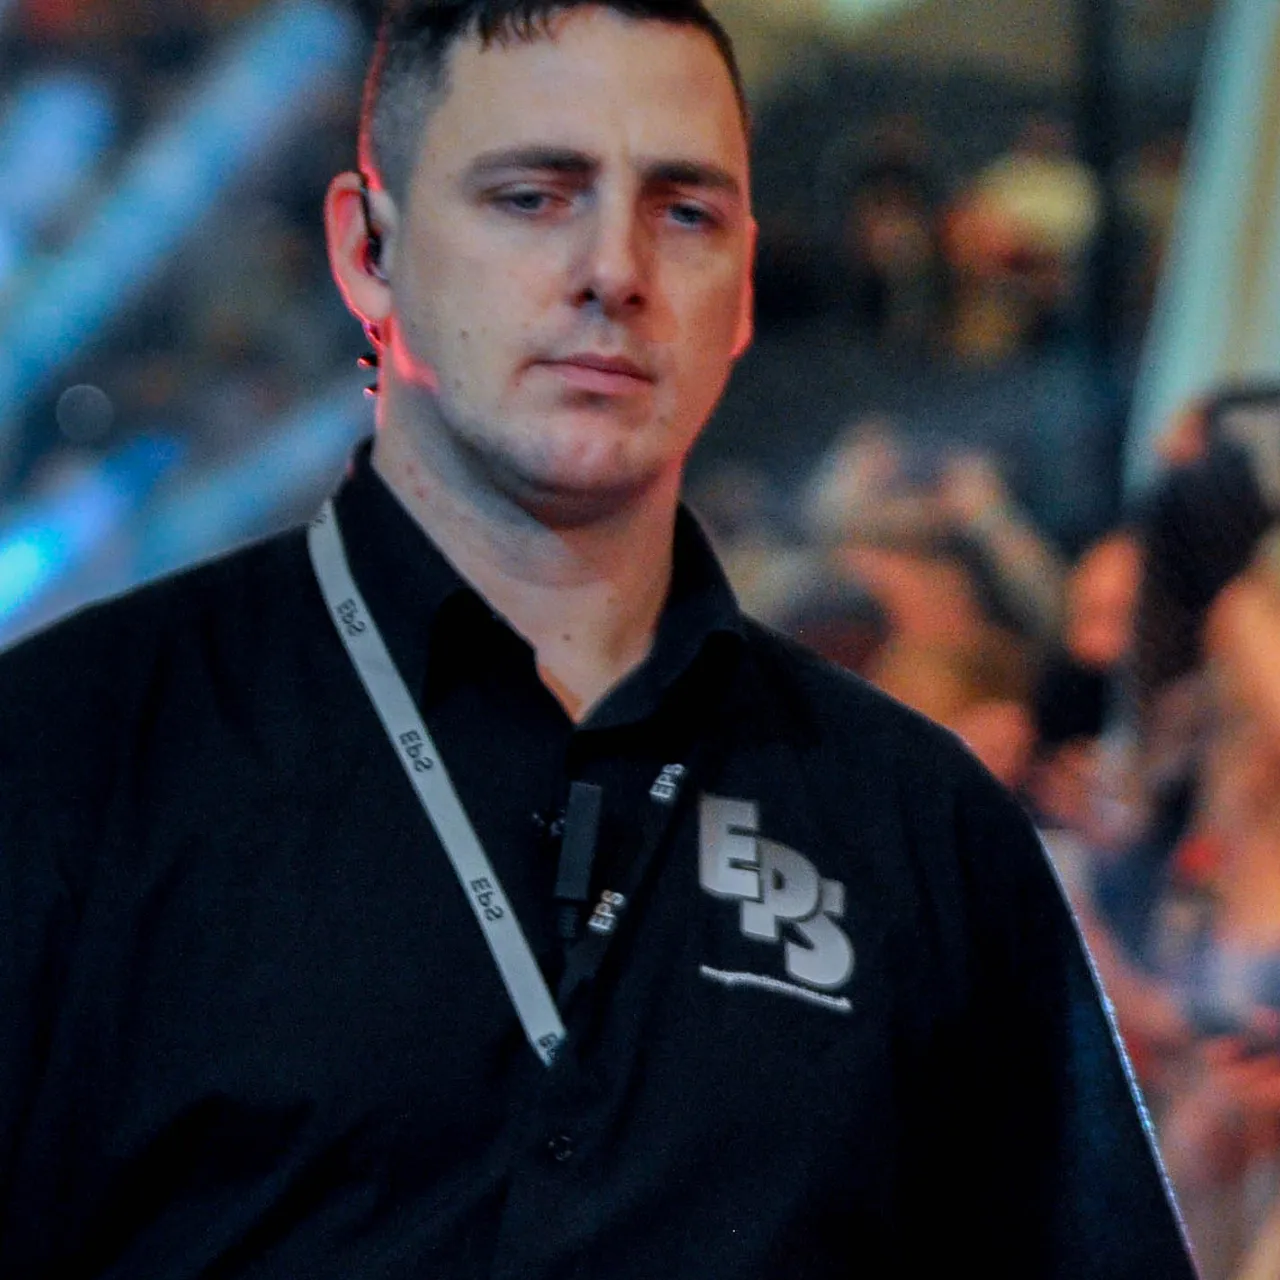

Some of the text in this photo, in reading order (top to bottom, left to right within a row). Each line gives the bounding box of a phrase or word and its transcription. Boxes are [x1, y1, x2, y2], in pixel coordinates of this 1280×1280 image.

[650, 763, 684, 799] EPS
[588, 889, 624, 932] EPS
[698, 796, 854, 990] EPS
